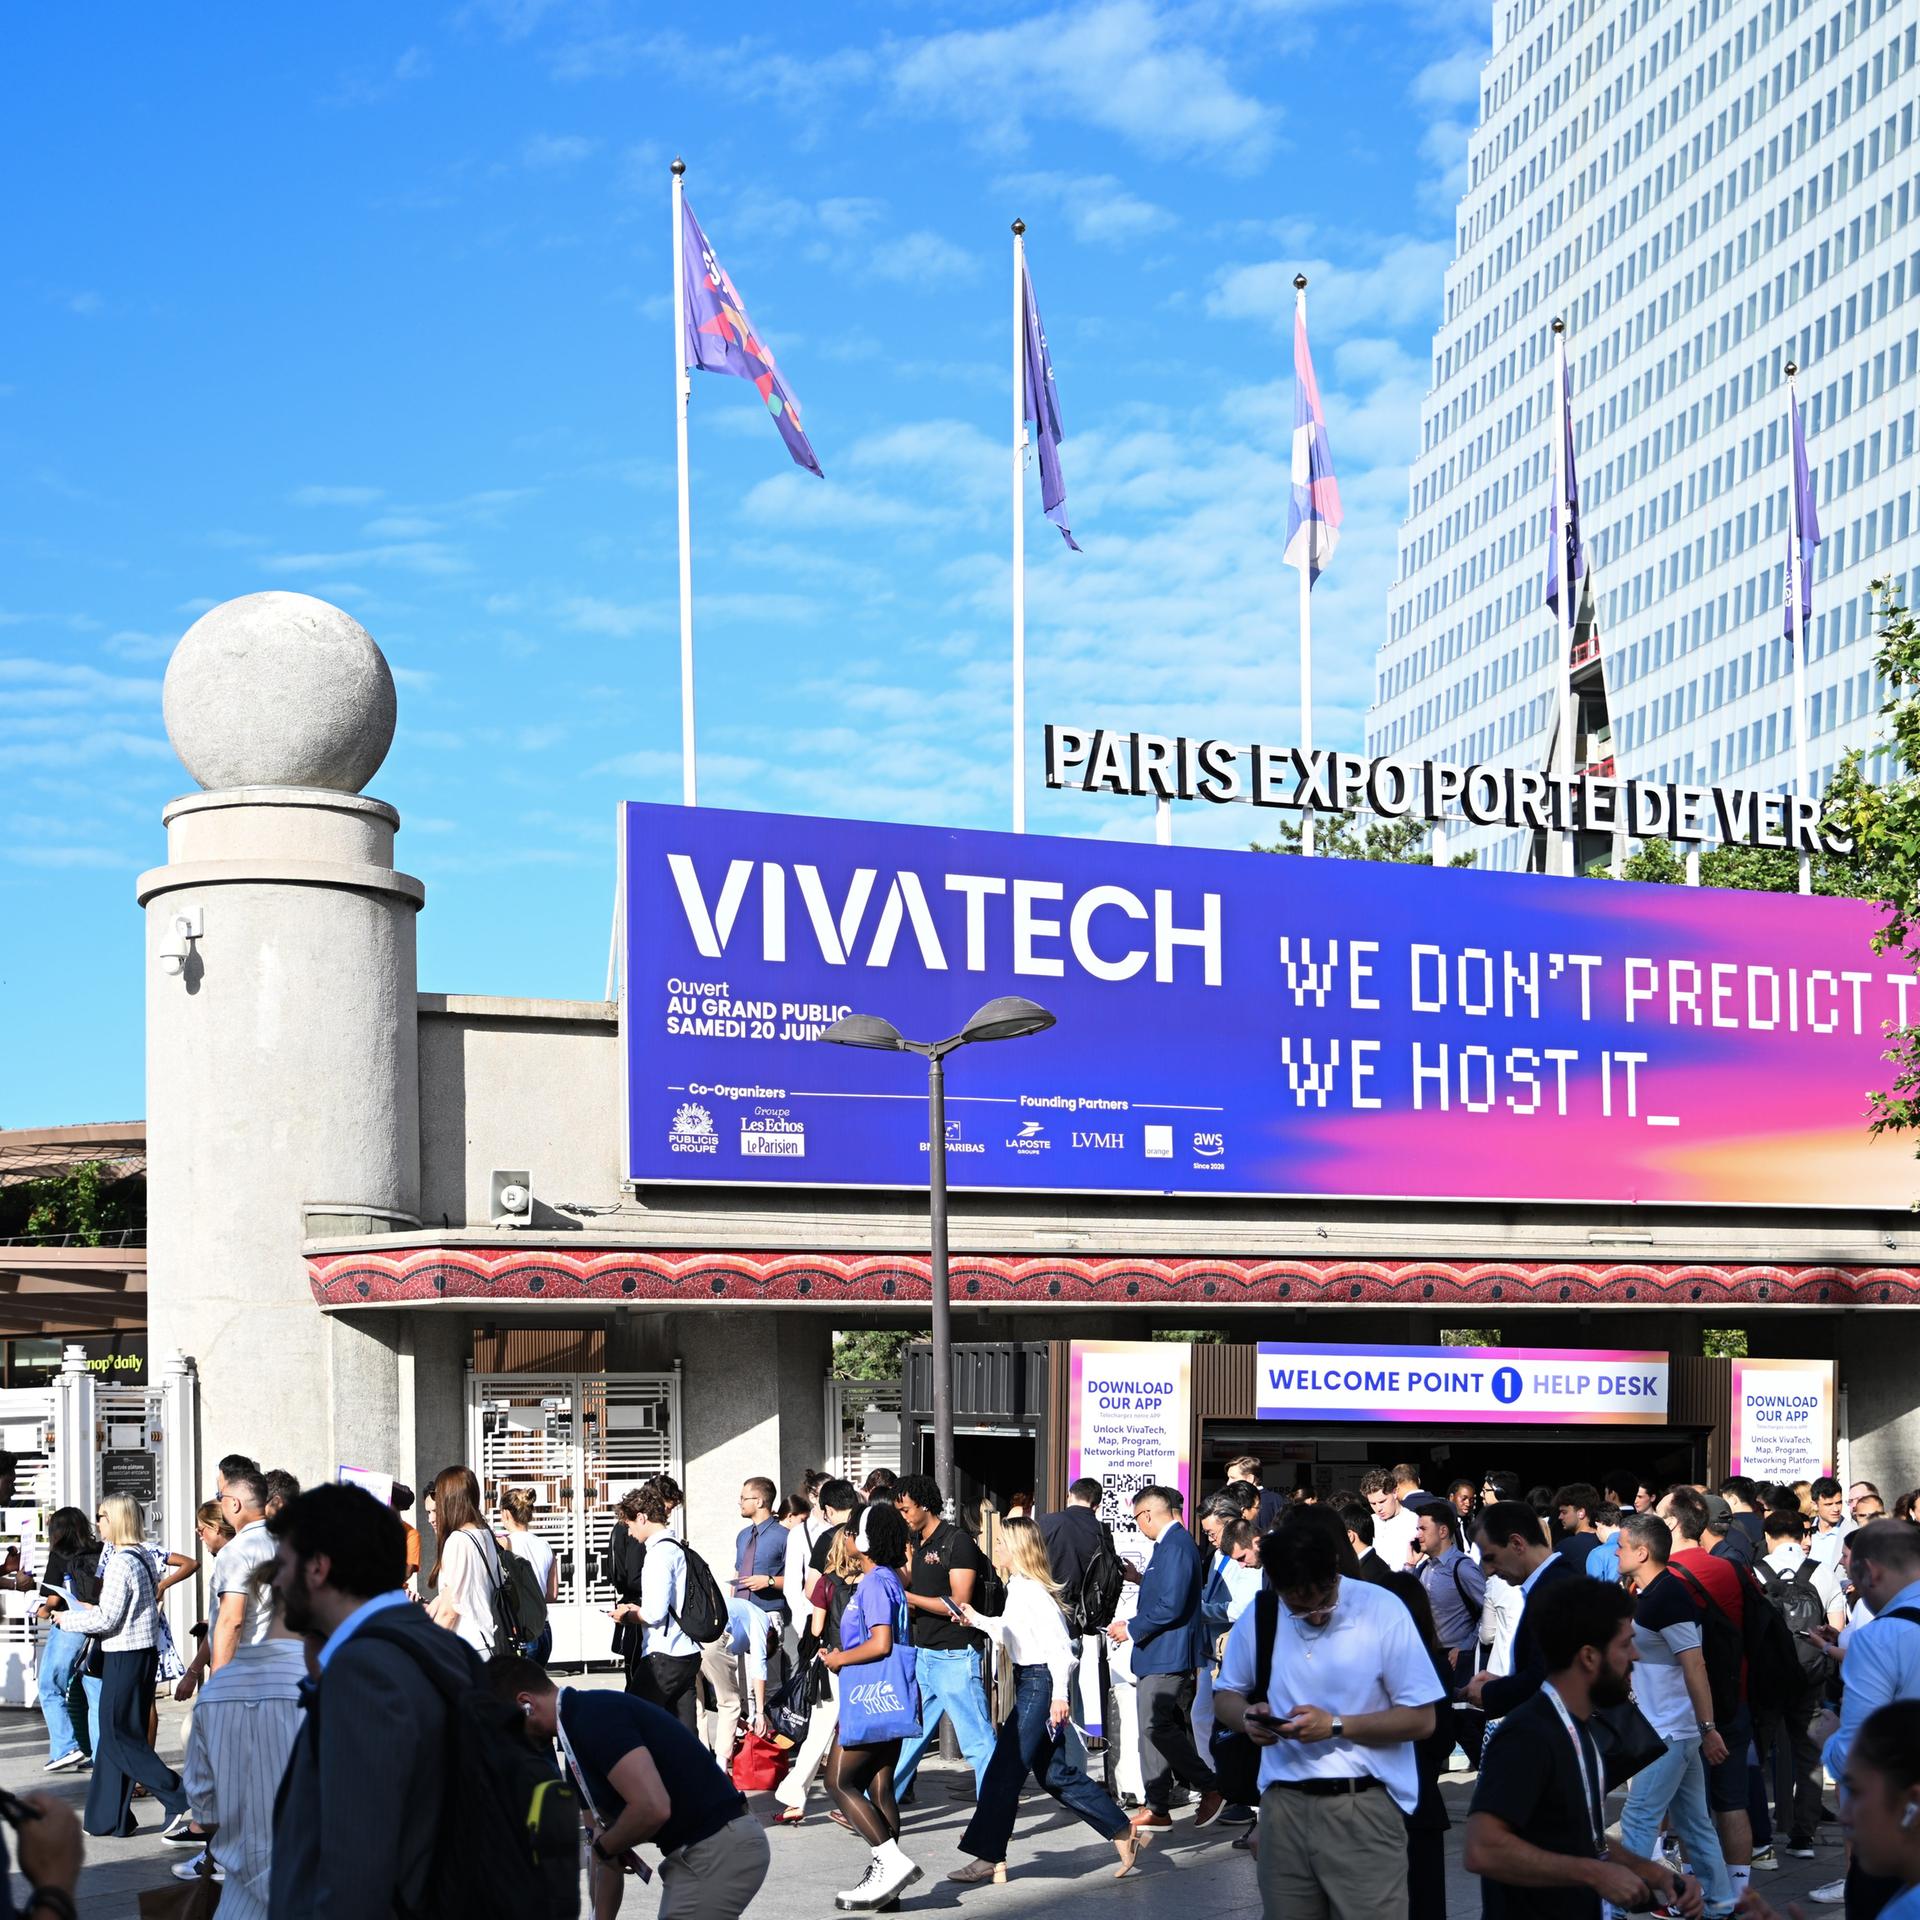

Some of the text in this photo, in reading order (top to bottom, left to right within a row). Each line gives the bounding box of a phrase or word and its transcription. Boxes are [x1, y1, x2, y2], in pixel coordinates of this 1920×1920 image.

[1044, 724, 1242, 804] PARIS
[1251, 744, 1413, 819] EXPO
[1423, 760, 1617, 832] PORTE
[1627, 779, 1708, 843] DE
[666, 853, 1223, 987] VIVATECH
[667, 977, 729, 998] Ouvert
[1280, 936, 1380, 1010] WE
[1410, 943, 1602, 1021] DON'T
[1625, 957, 1872, 1035] PREDICT
[667, 996, 852, 1023] AU GRAND PUBLIC
[667, 1016, 827, 1042] SAMEDI 20 JUIN
[1281, 1036, 1382, 1109] WE
[1412, 1041, 1579, 1116] HOST
[688, 1083, 786, 1101] Co-Organizers
[1020, 1095, 1129, 1112] Founding Partners
[754, 1106, 790, 1119] Groupe
[668, 1134, 719, 1145] PUBLICIS
[758, 1136, 798, 1154] Parisien
[1005, 1139, 1051, 1149] LA POSTE
[1071, 1132, 1125, 1149] LVMH
[1193, 1132, 1223, 1146] aws
[671, 1144, 717, 1154] GROUPE
[944, 1142, 985, 1153] PARIBAS
[1146, 1148, 1170, 1156] orange
[1088, 1380, 1174, 1395] DOWNLOAD
[1268, 1368, 1658, 1399] WELCOME POINT 1 HELP DESK
[1099, 1396, 1162, 1410] OUR APP
[1746, 1395, 1818, 1408] DOWNLOAD
[1755, 1410, 1809, 1422] OUR APP
[1093, 1425, 1167, 1435] Unlock VivaTech,
[1098, 1436, 1161, 1447] Map, Program,
[1751, 1435, 1813, 1445] Unlock VivaTech,
[1084, 1447, 1175, 1458] Networking Platform
[1755, 1446, 1809, 1456] Map, Program,
[1107, 1459, 1153, 1468] and more!
[1743, 1456, 1820, 1466] Networking Platform
[1763, 1466, 1801, 1475] and more!
